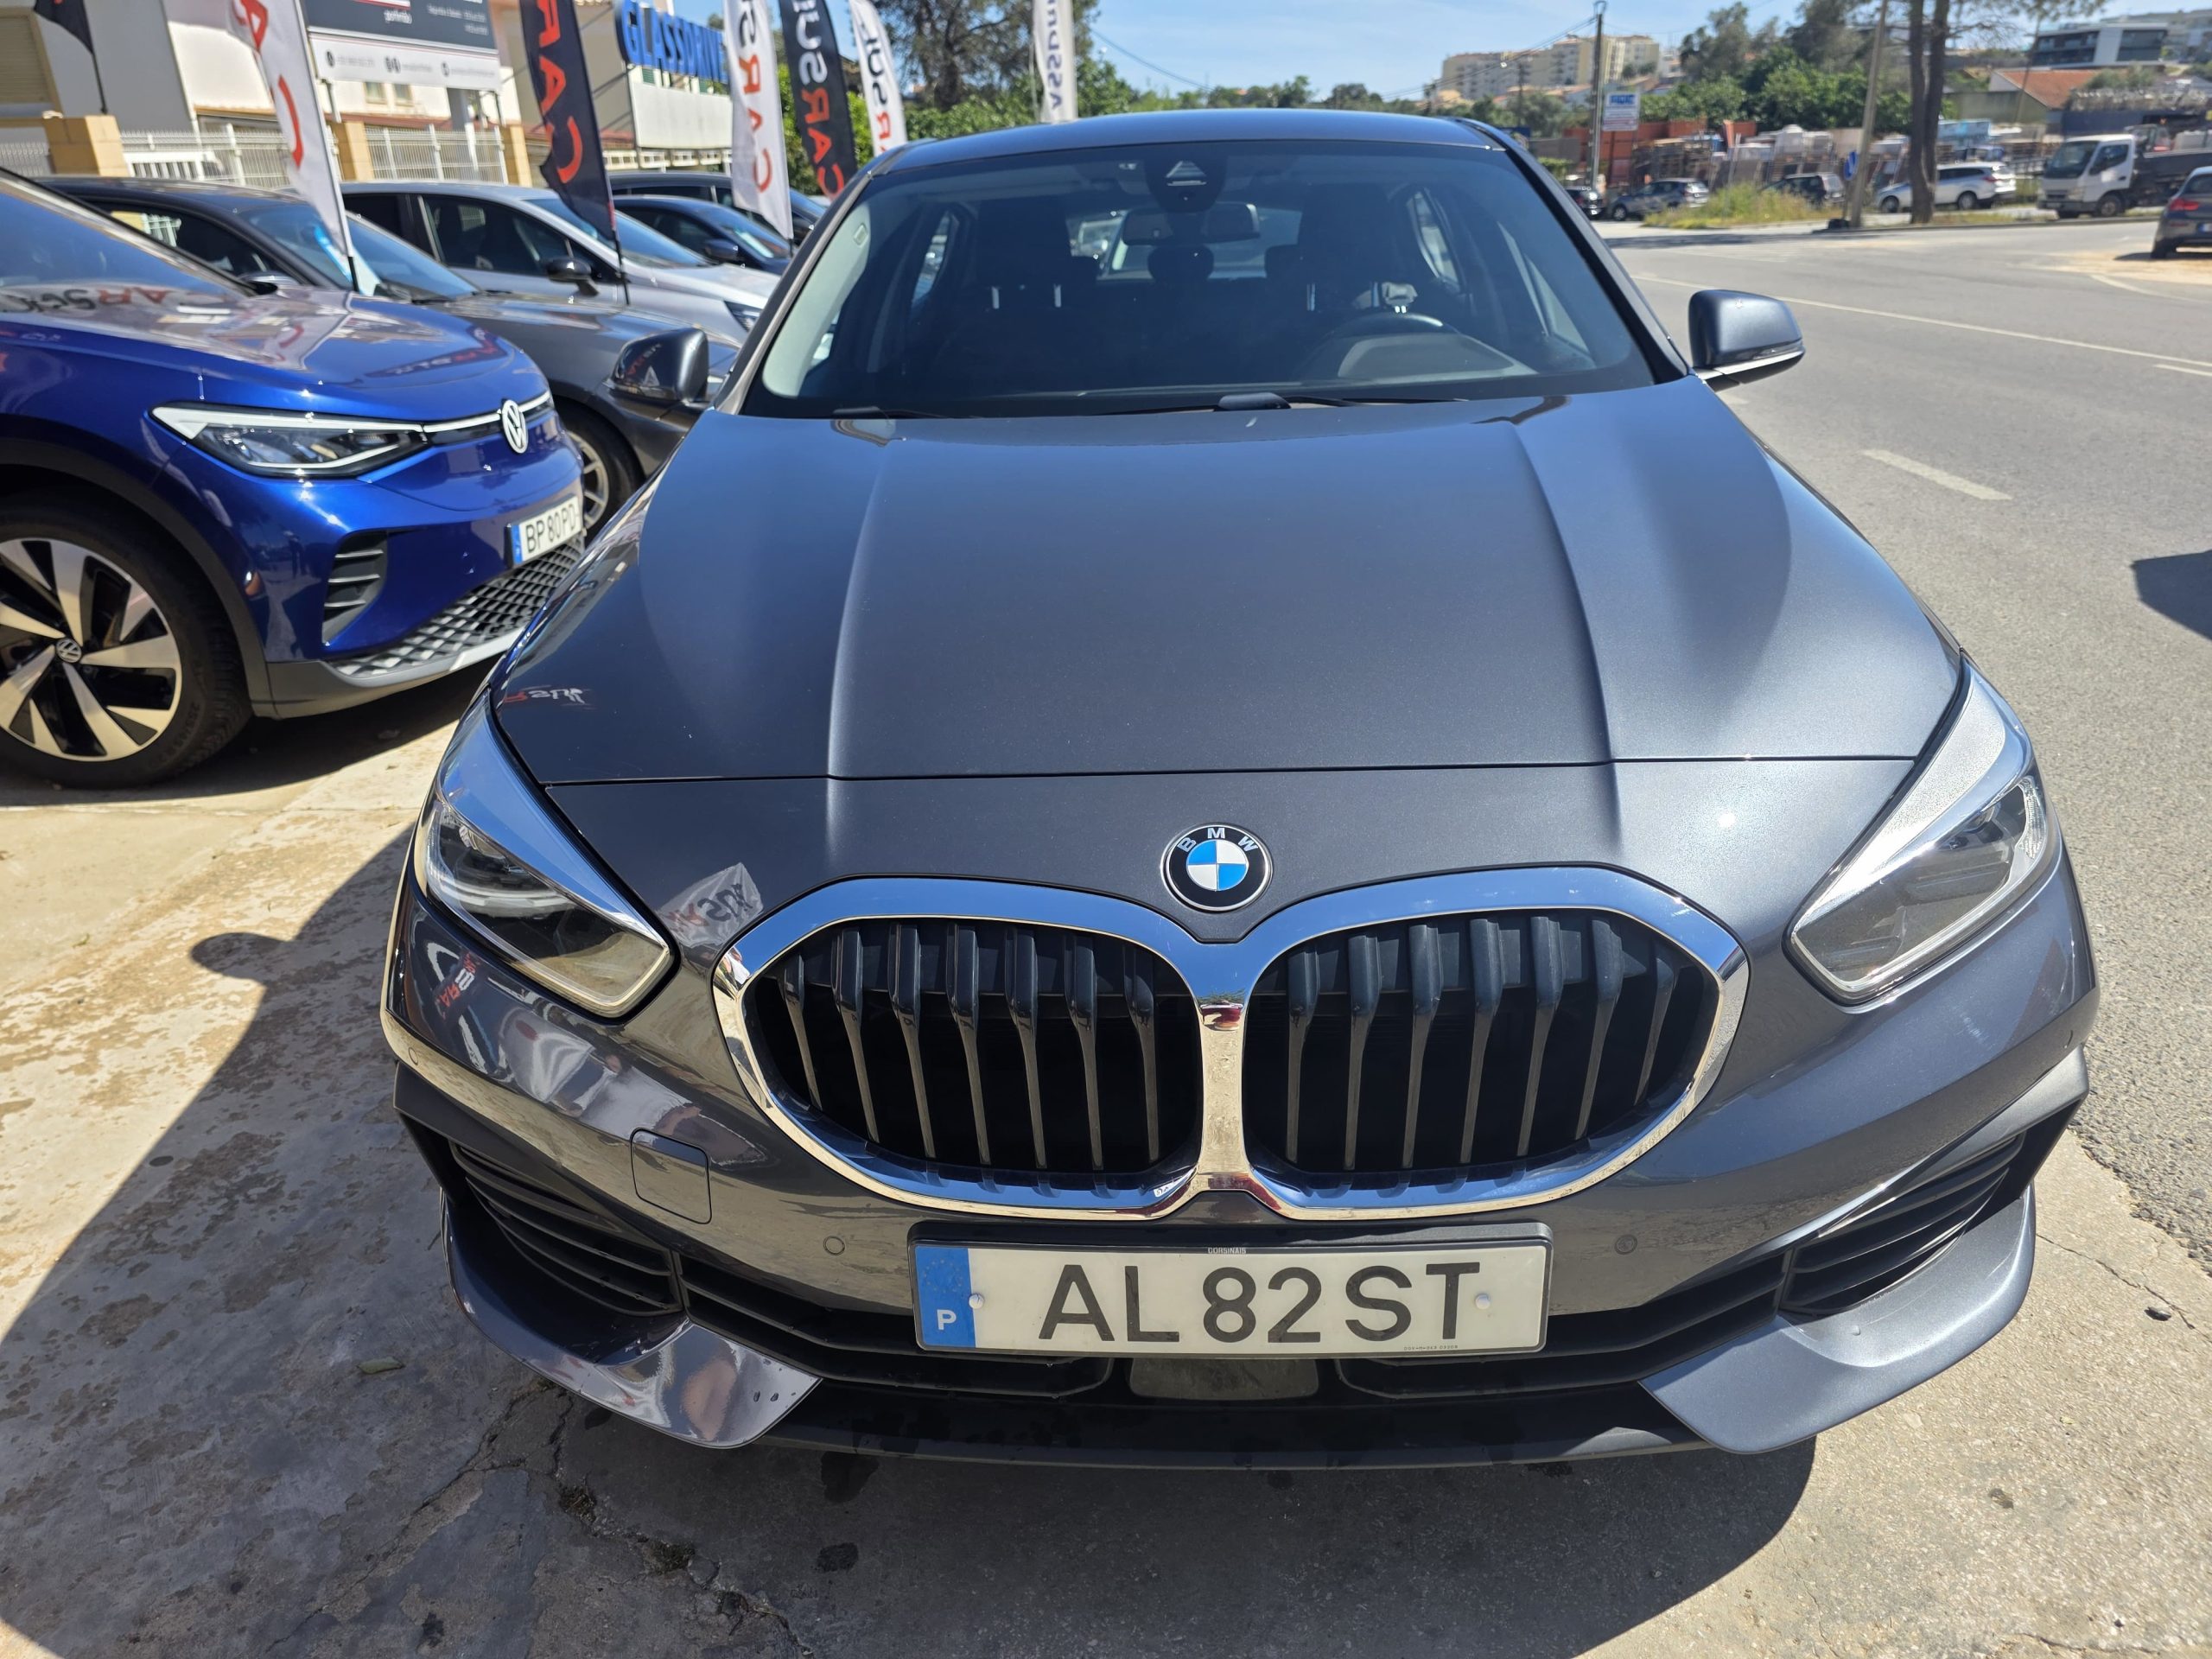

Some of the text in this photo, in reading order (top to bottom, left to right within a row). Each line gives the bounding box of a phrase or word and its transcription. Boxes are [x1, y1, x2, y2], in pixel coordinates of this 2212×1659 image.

[525, 519, 545, 553] BP
[547, 511, 562, 543] 80
[1176, 827, 1259, 853] BMW
[937, 1262, 1481, 1344] P AL 82 ST
